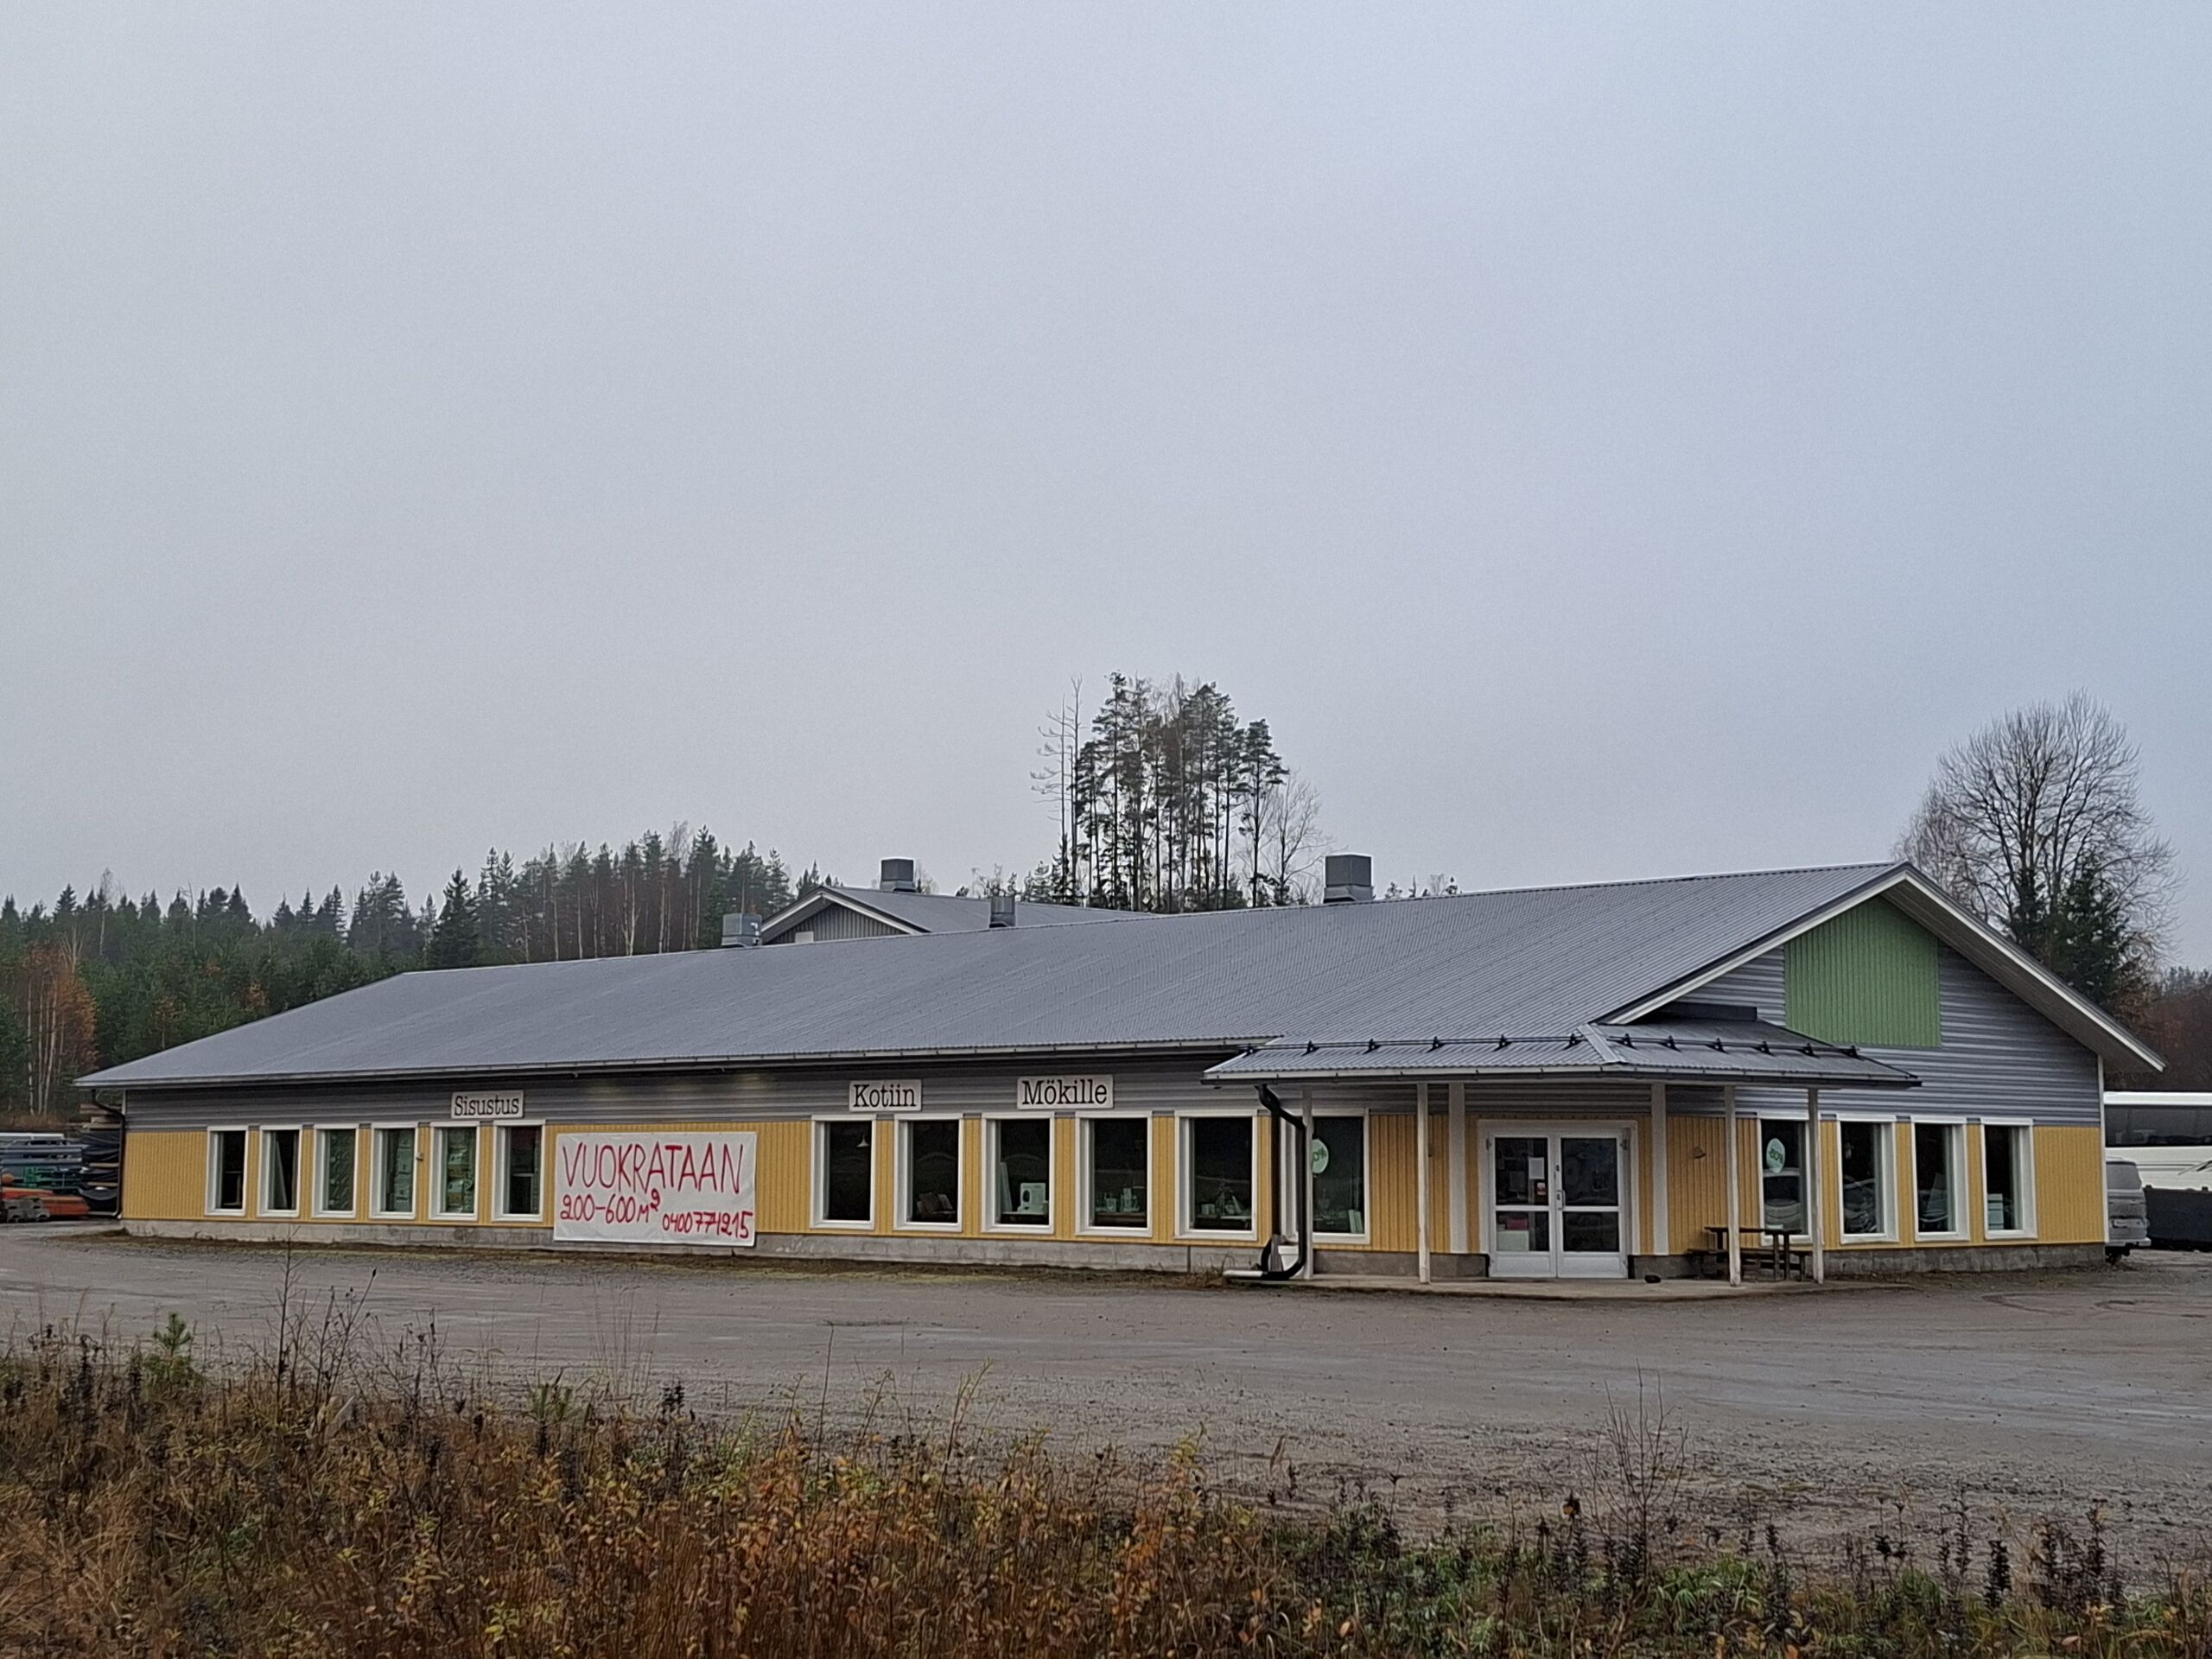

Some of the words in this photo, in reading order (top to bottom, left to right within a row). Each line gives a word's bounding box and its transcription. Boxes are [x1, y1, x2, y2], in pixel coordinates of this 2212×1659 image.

[853, 1084, 916, 1108] Kotiin
[1021, 1079, 1107, 1105] Mökille
[454, 1095, 519, 1116] Sisustus
[563, 1141, 743, 1193] VUOKRATAAN
